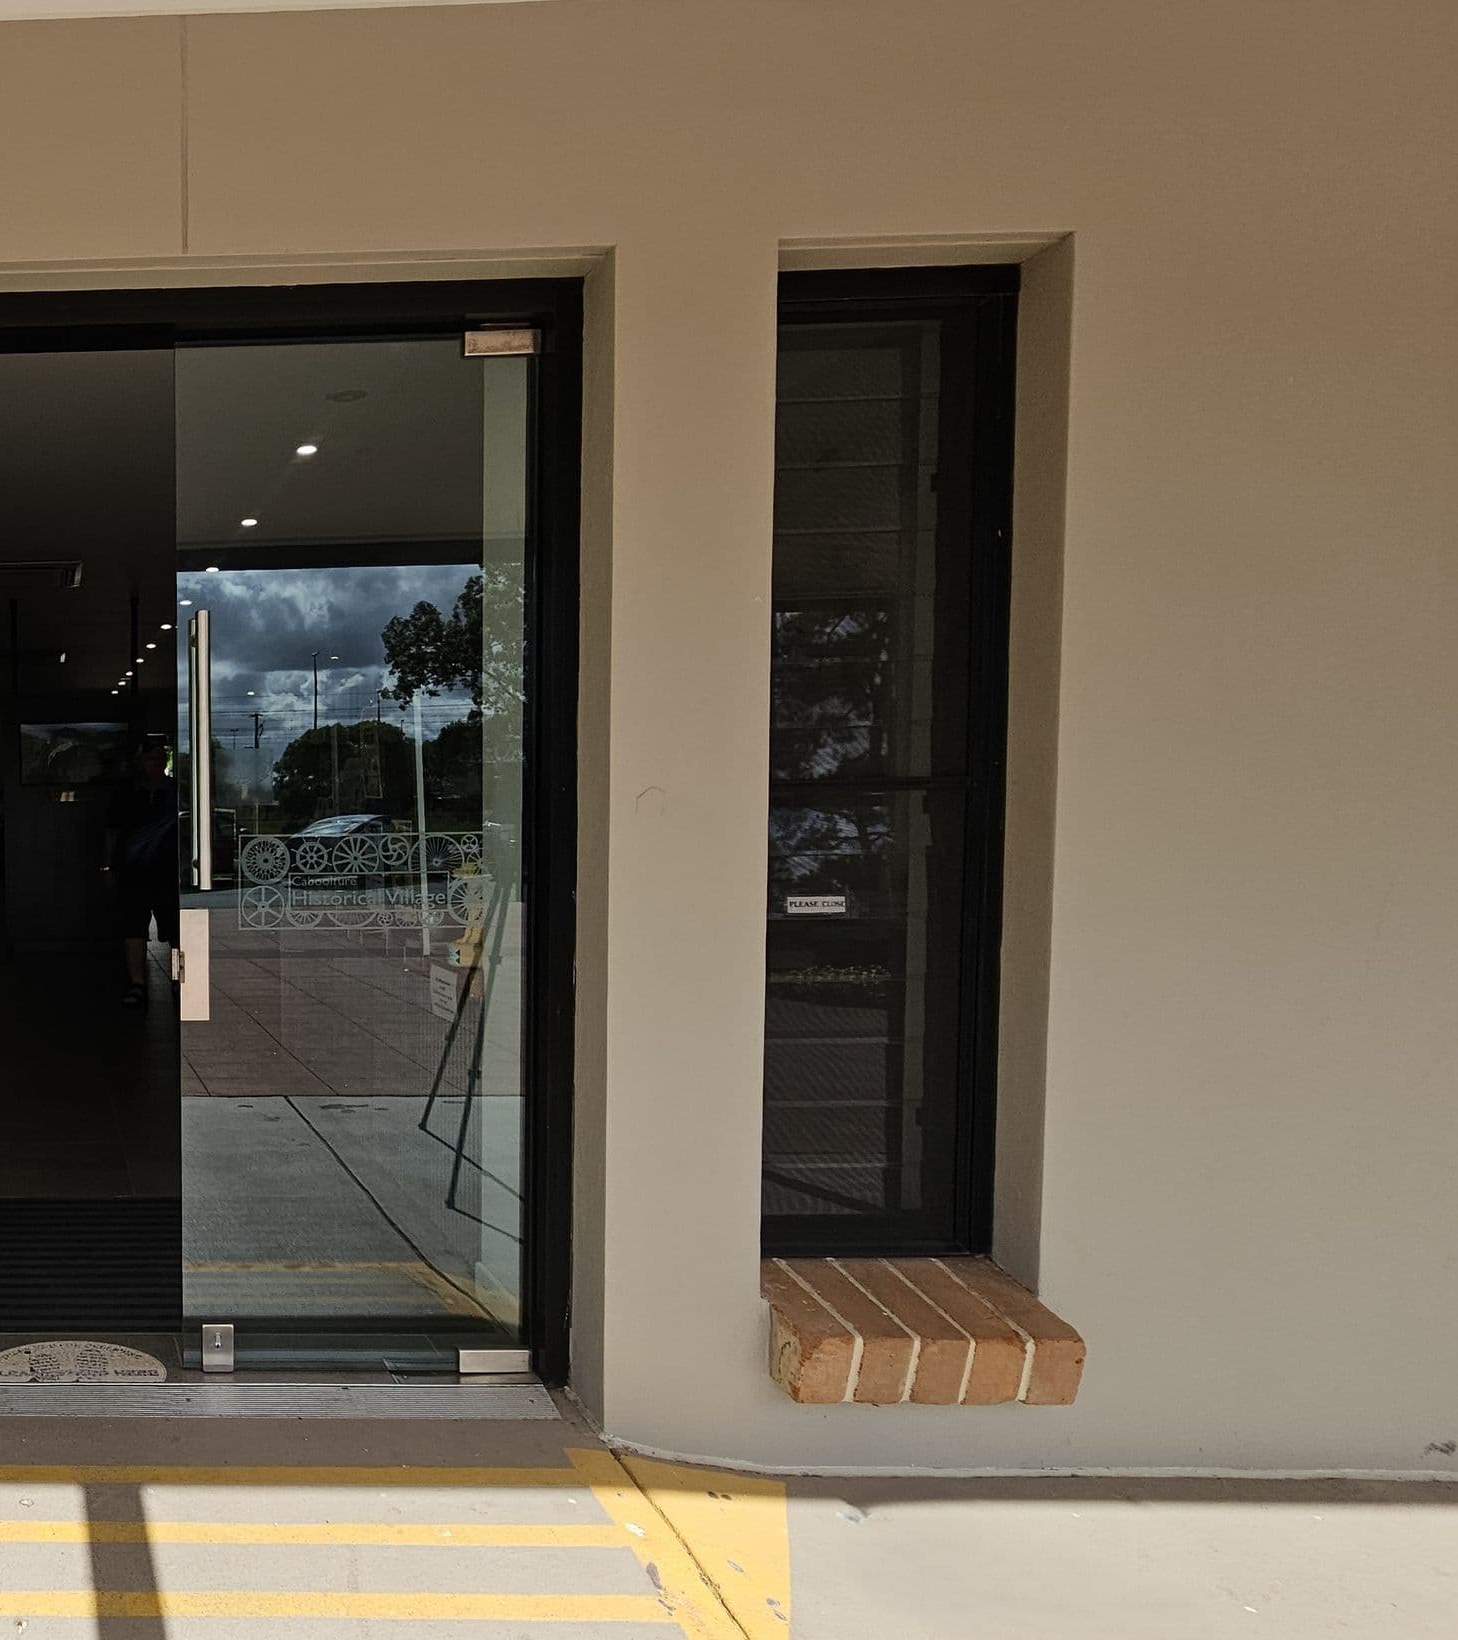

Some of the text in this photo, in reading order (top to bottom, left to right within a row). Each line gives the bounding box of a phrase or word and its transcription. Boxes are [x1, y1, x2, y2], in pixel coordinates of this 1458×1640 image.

[291, 875, 358, 887] Caboolture
[292, 888, 447, 909] Historical Village
[789, 900, 819, 908] PLEASE
